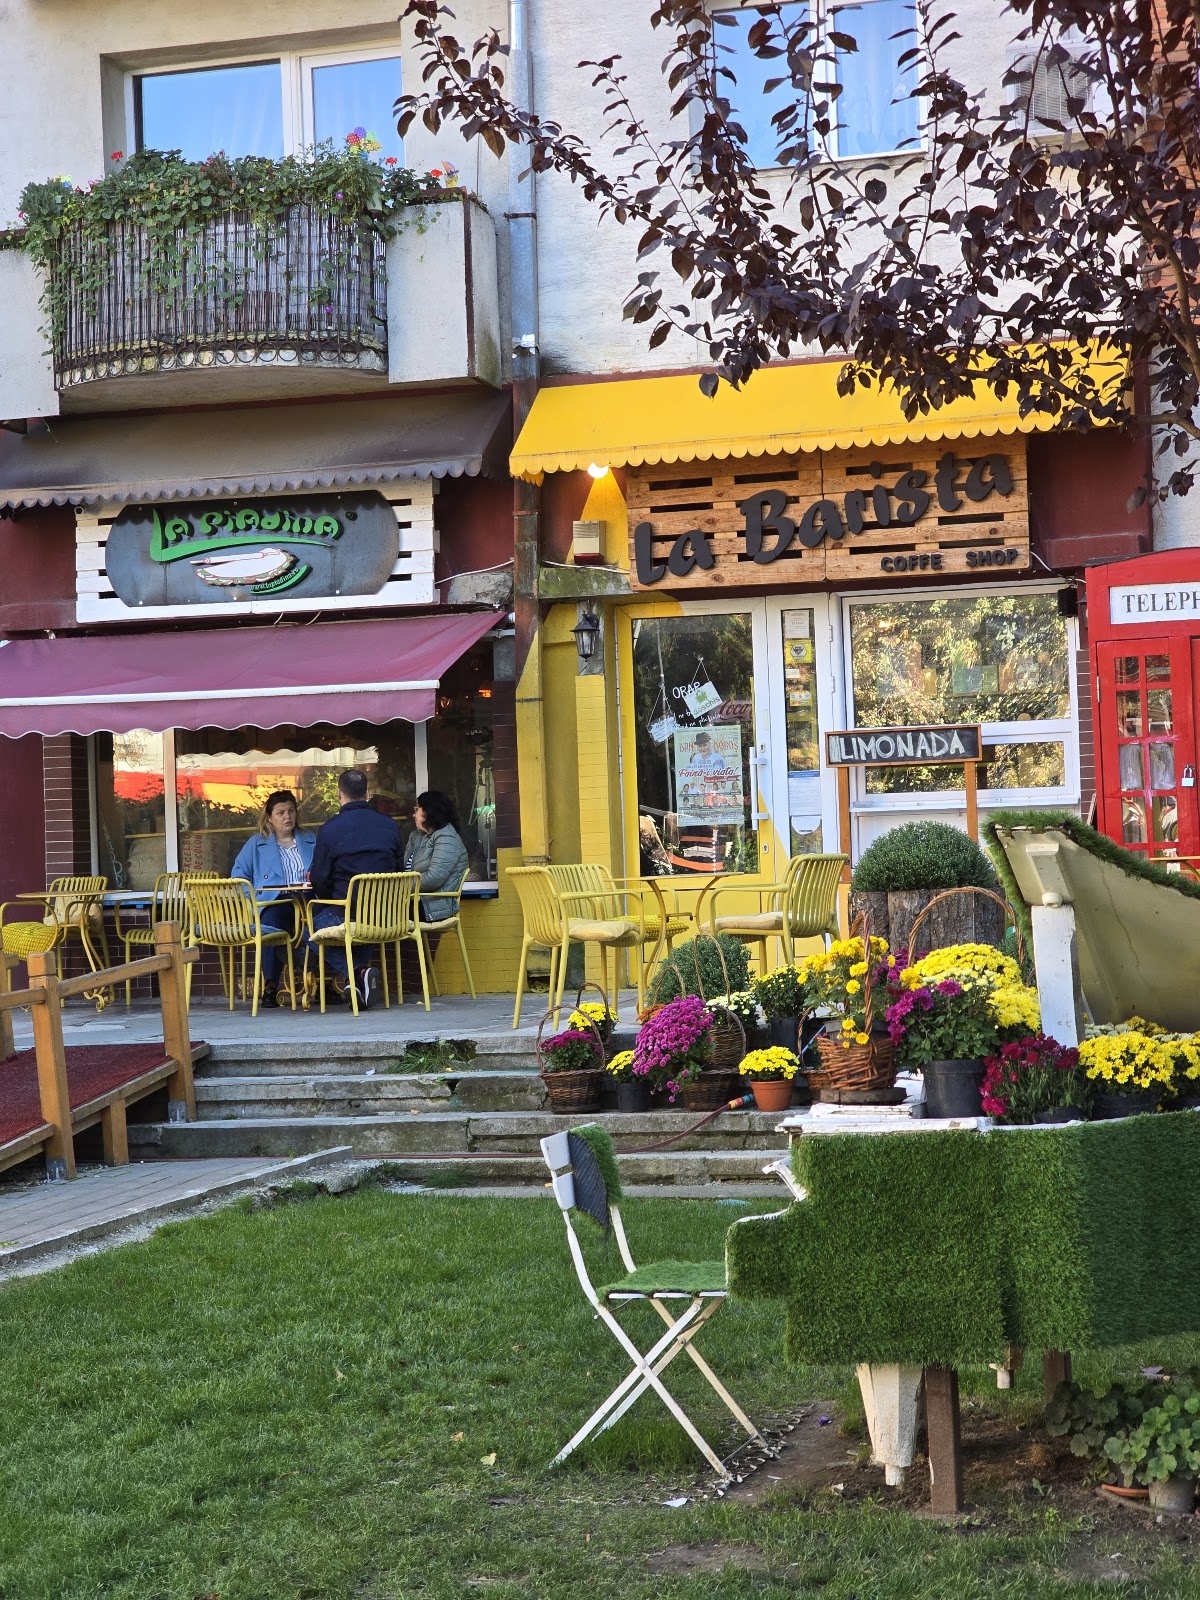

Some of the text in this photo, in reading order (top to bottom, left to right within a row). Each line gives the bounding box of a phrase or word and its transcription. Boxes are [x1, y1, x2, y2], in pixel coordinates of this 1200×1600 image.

[634, 452, 1014, 586] La Barista
[880, 548, 1019, 573] COFFE SHOP
[839, 729, 966, 761] LIMONADA
